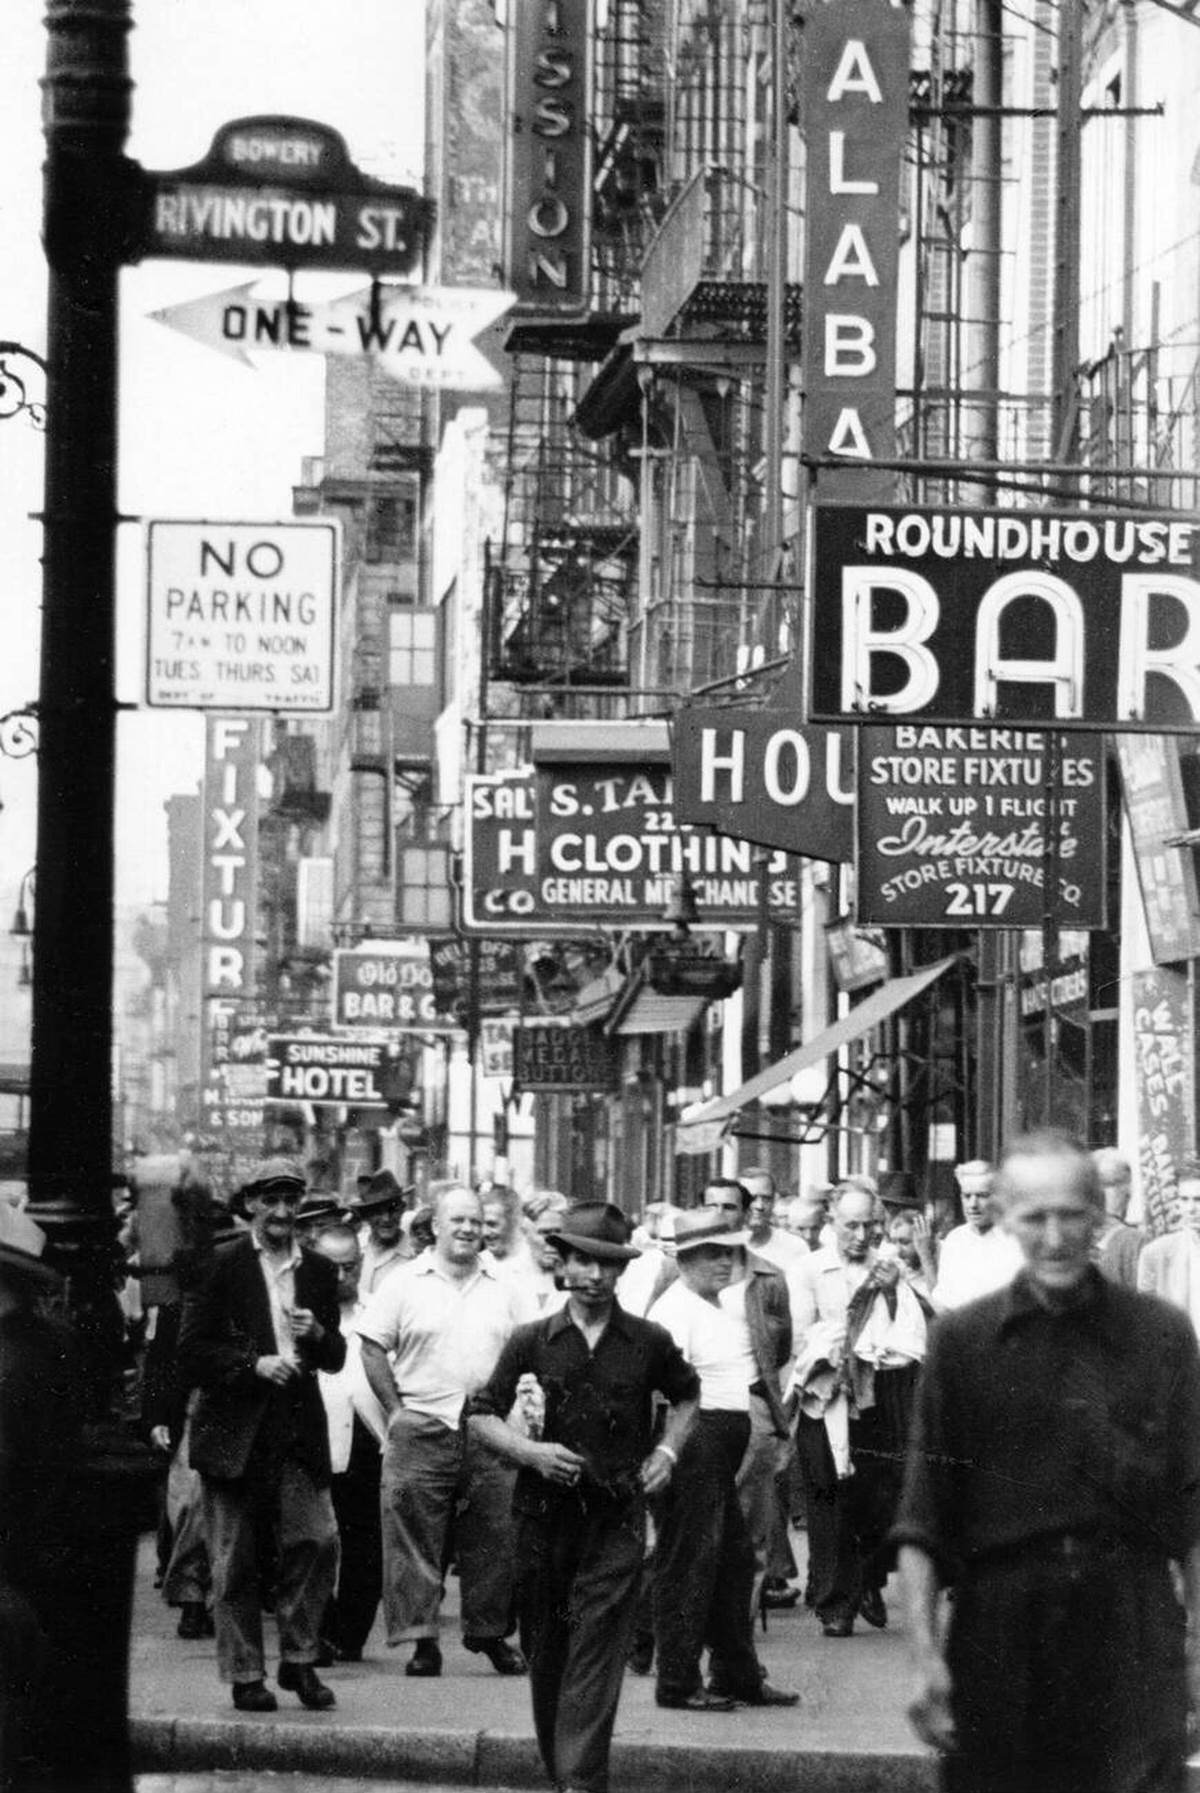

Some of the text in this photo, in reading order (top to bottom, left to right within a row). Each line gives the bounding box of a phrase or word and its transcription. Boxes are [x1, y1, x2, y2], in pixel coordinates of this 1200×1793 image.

[227, 136, 325, 166] BOWERY
[156, 192, 407, 251] RIVINGTON ST.
[822, 39, 883, 460] ALABA
[866, 513, 1193, 564] ROUNDHOUSE
[201, 540, 284, 578] NO
[166, 588, 316, 625] PARKING
[225, 633, 246, 652] TO
[258, 636, 307, 654] NOON
[841, 565, 1200, 722] BAR
[155, 659, 200, 681] TUES
[216, 661, 276, 684] THURS
[896, 725, 1068, 751] BAKERIE
[870, 756, 1094, 787] STORE FIXTUES
[473, 786, 536, 820] SAL
[886, 796, 943, 816] WALK
[949, 796, 978, 816] UP
[985, 794, 994, 816] 1
[642, 811, 695, 831] 22
[541, 877, 638, 905] GENERAL
[879, 858, 952, 903] STORE
[955, 856, 1045, 888] FIXTURE
[484, 888, 536, 915] CO
[944, 883, 1016, 916] 217
[344, 991, 394, 1020] BAR
[398, 994, 416, 1020] &
[287, 1042, 382, 1068] SUNSHINE
[282, 1065, 383, 1099] HOTEL
